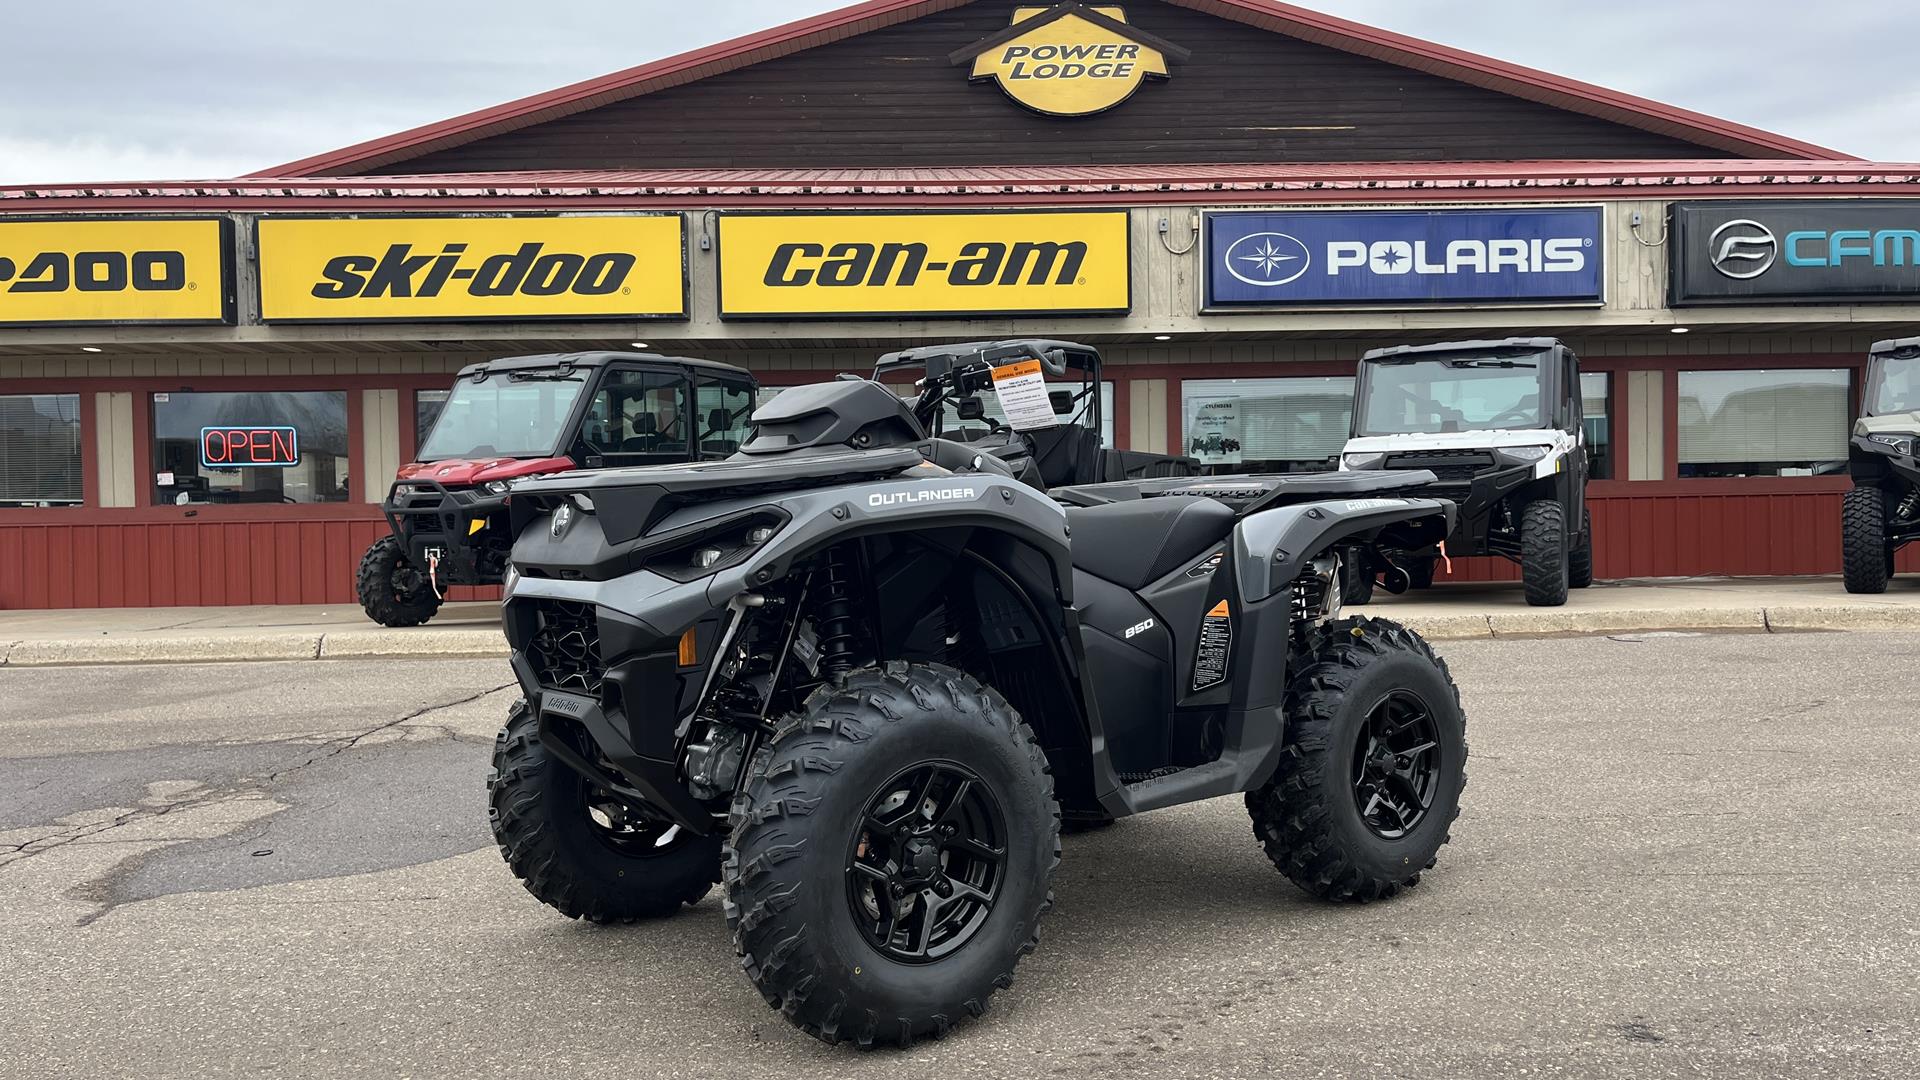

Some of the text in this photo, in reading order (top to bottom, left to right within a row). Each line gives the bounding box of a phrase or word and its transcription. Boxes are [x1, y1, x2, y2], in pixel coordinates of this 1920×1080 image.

[1001, 44, 1140, 64] POWER
[1009, 61, 1135, 80] LODGE
[1327, 238, 1585, 275] POLARIS
[1785, 229, 1920, 267] CFM
[311, 242, 636, 299] ski-doo
[763, 241, 1087, 287] can-am
[206, 431, 293, 462] OPEN
[868, 488, 975, 507] OUTLANDER
[1125, 618, 1154, 639] 850
